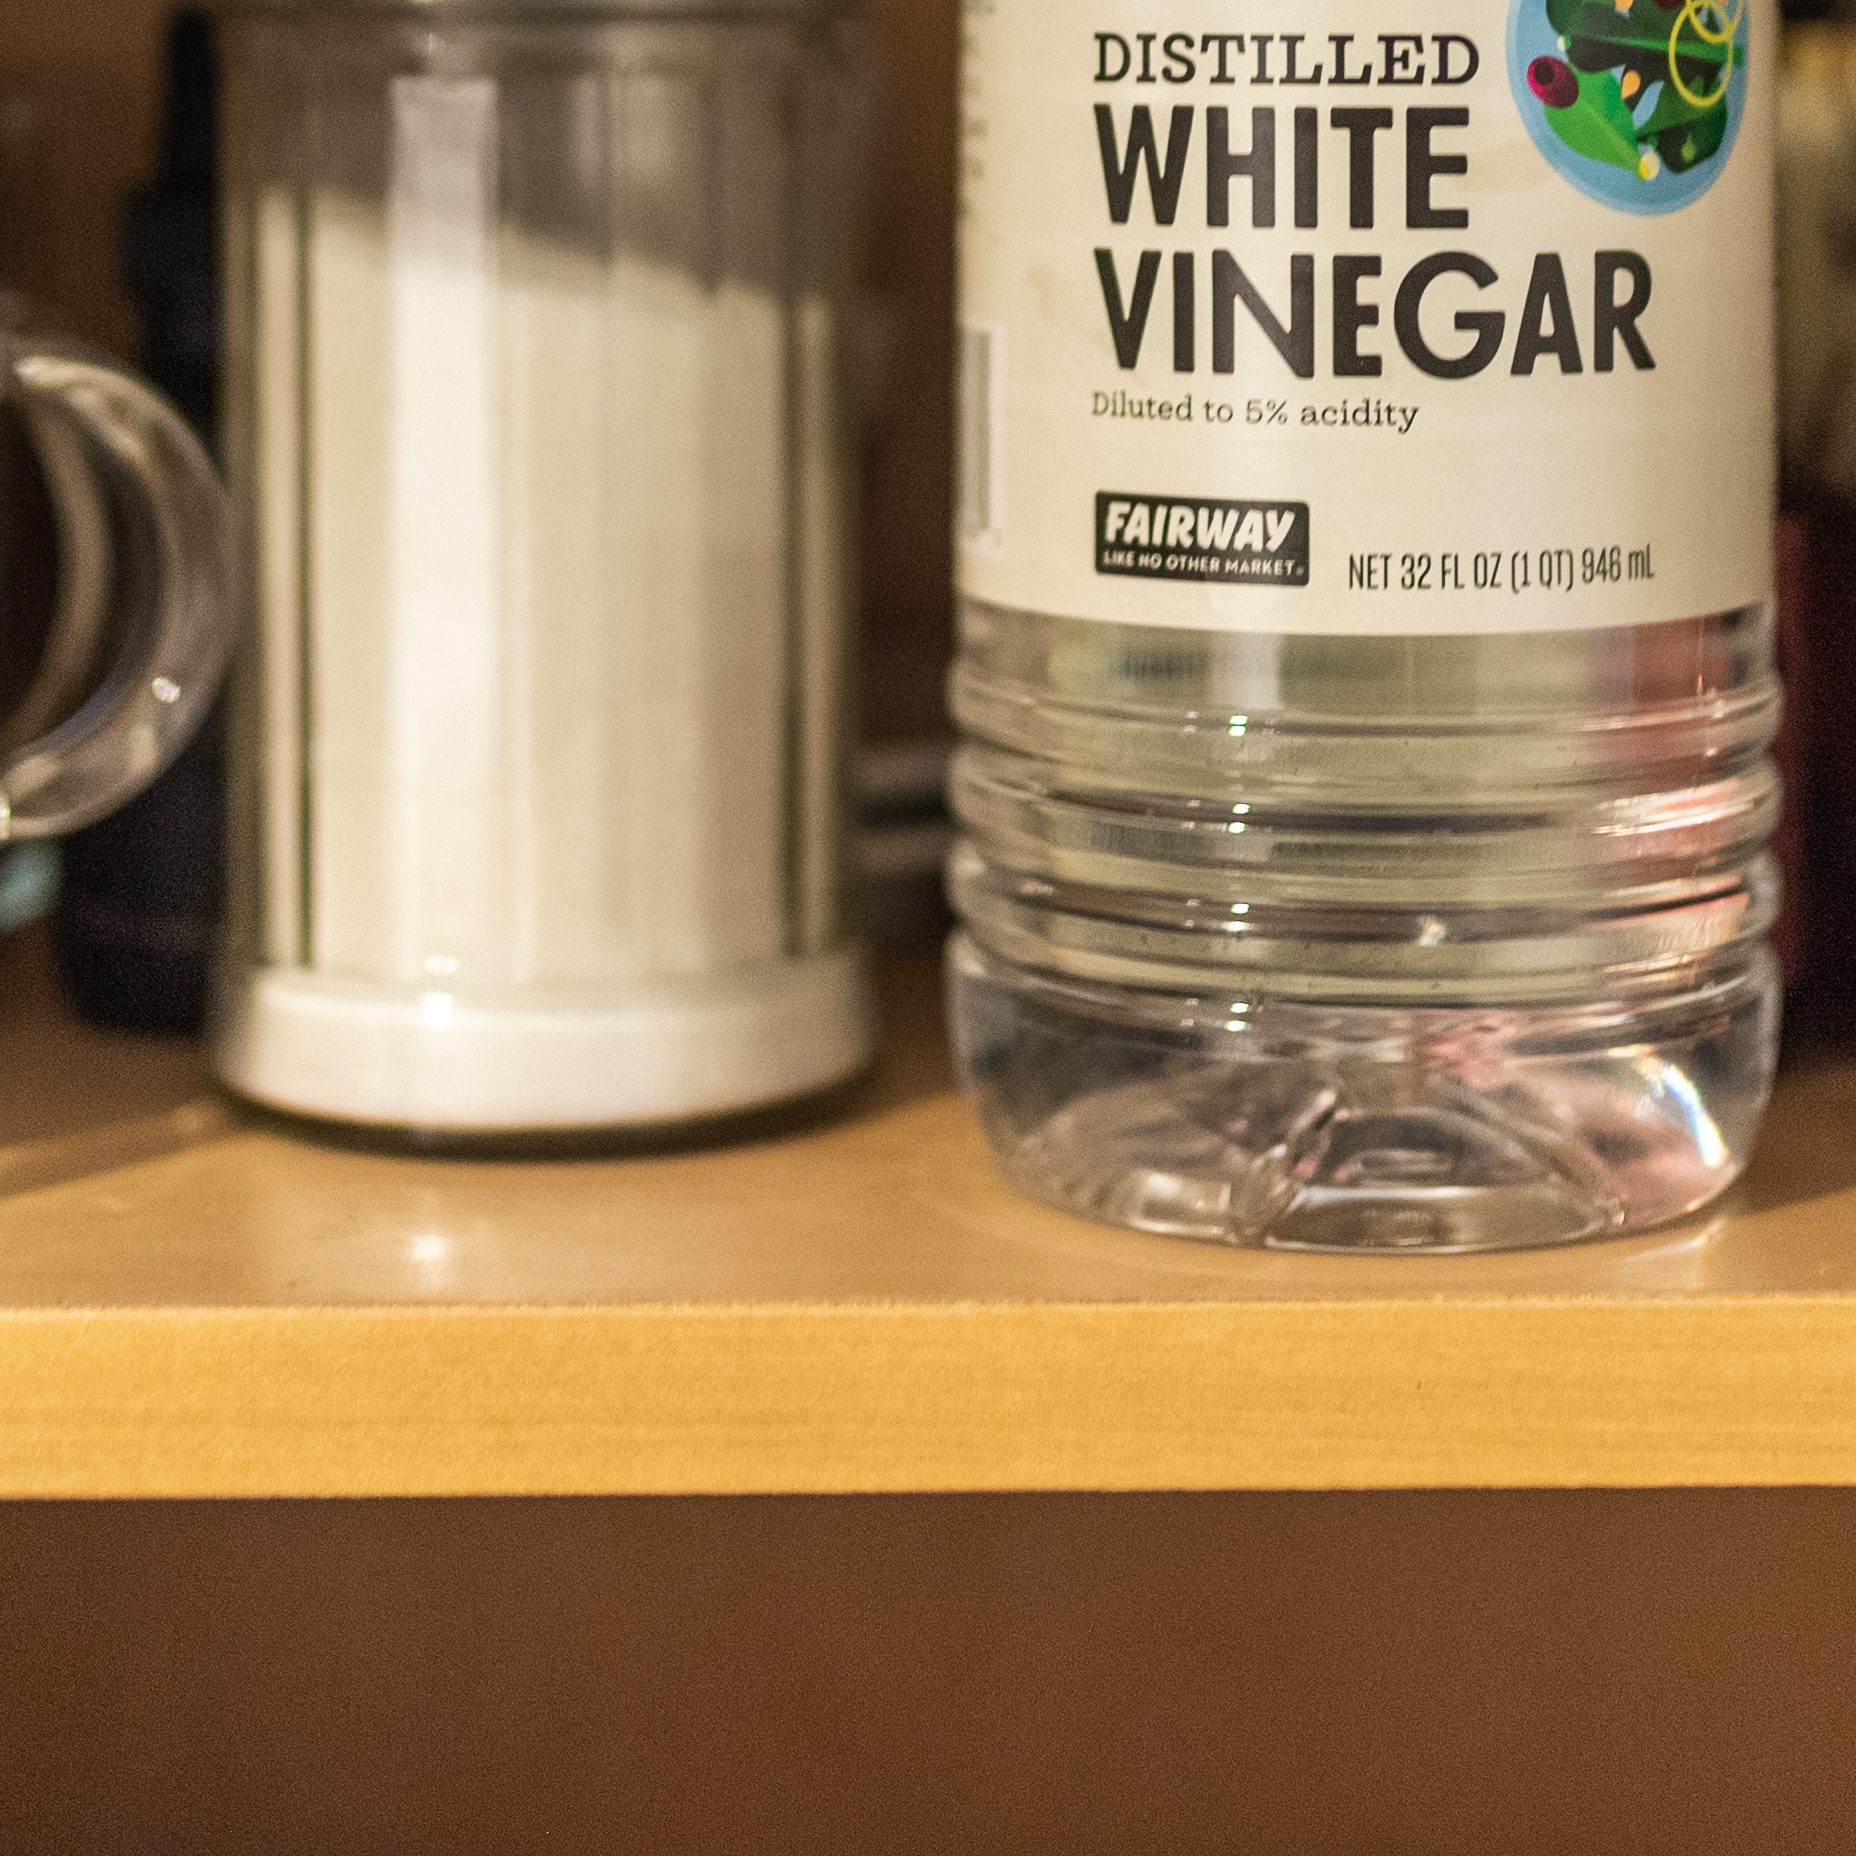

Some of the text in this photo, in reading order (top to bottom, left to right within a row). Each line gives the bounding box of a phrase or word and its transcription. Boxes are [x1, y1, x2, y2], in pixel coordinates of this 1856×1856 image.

[1093, 32, 1480, 86] DISTILLED
[1092, 102, 1470, 231] WHITE
[1093, 247, 1658, 381] VINEGAR
[1091, 390, 1420, 435] Diluted to 5% acidity
[1105, 502, 1295, 553] FAIRWAY
[1103, 551, 1134, 568] LIKE
[1137, 553, 1163, 570] NO
[1165, 554, 1221, 573] OTHER
[1348, 553, 1392, 590] NET
[1400, 553, 1432, 590] 32
[1440, 552, 1465, 590] FL
[1472, 551, 1503, 590] OZ
[1510, 551, 1531, 595] (1
[1538, 548, 1575, 592] QT)
[1581, 545, 1622, 584] 946
